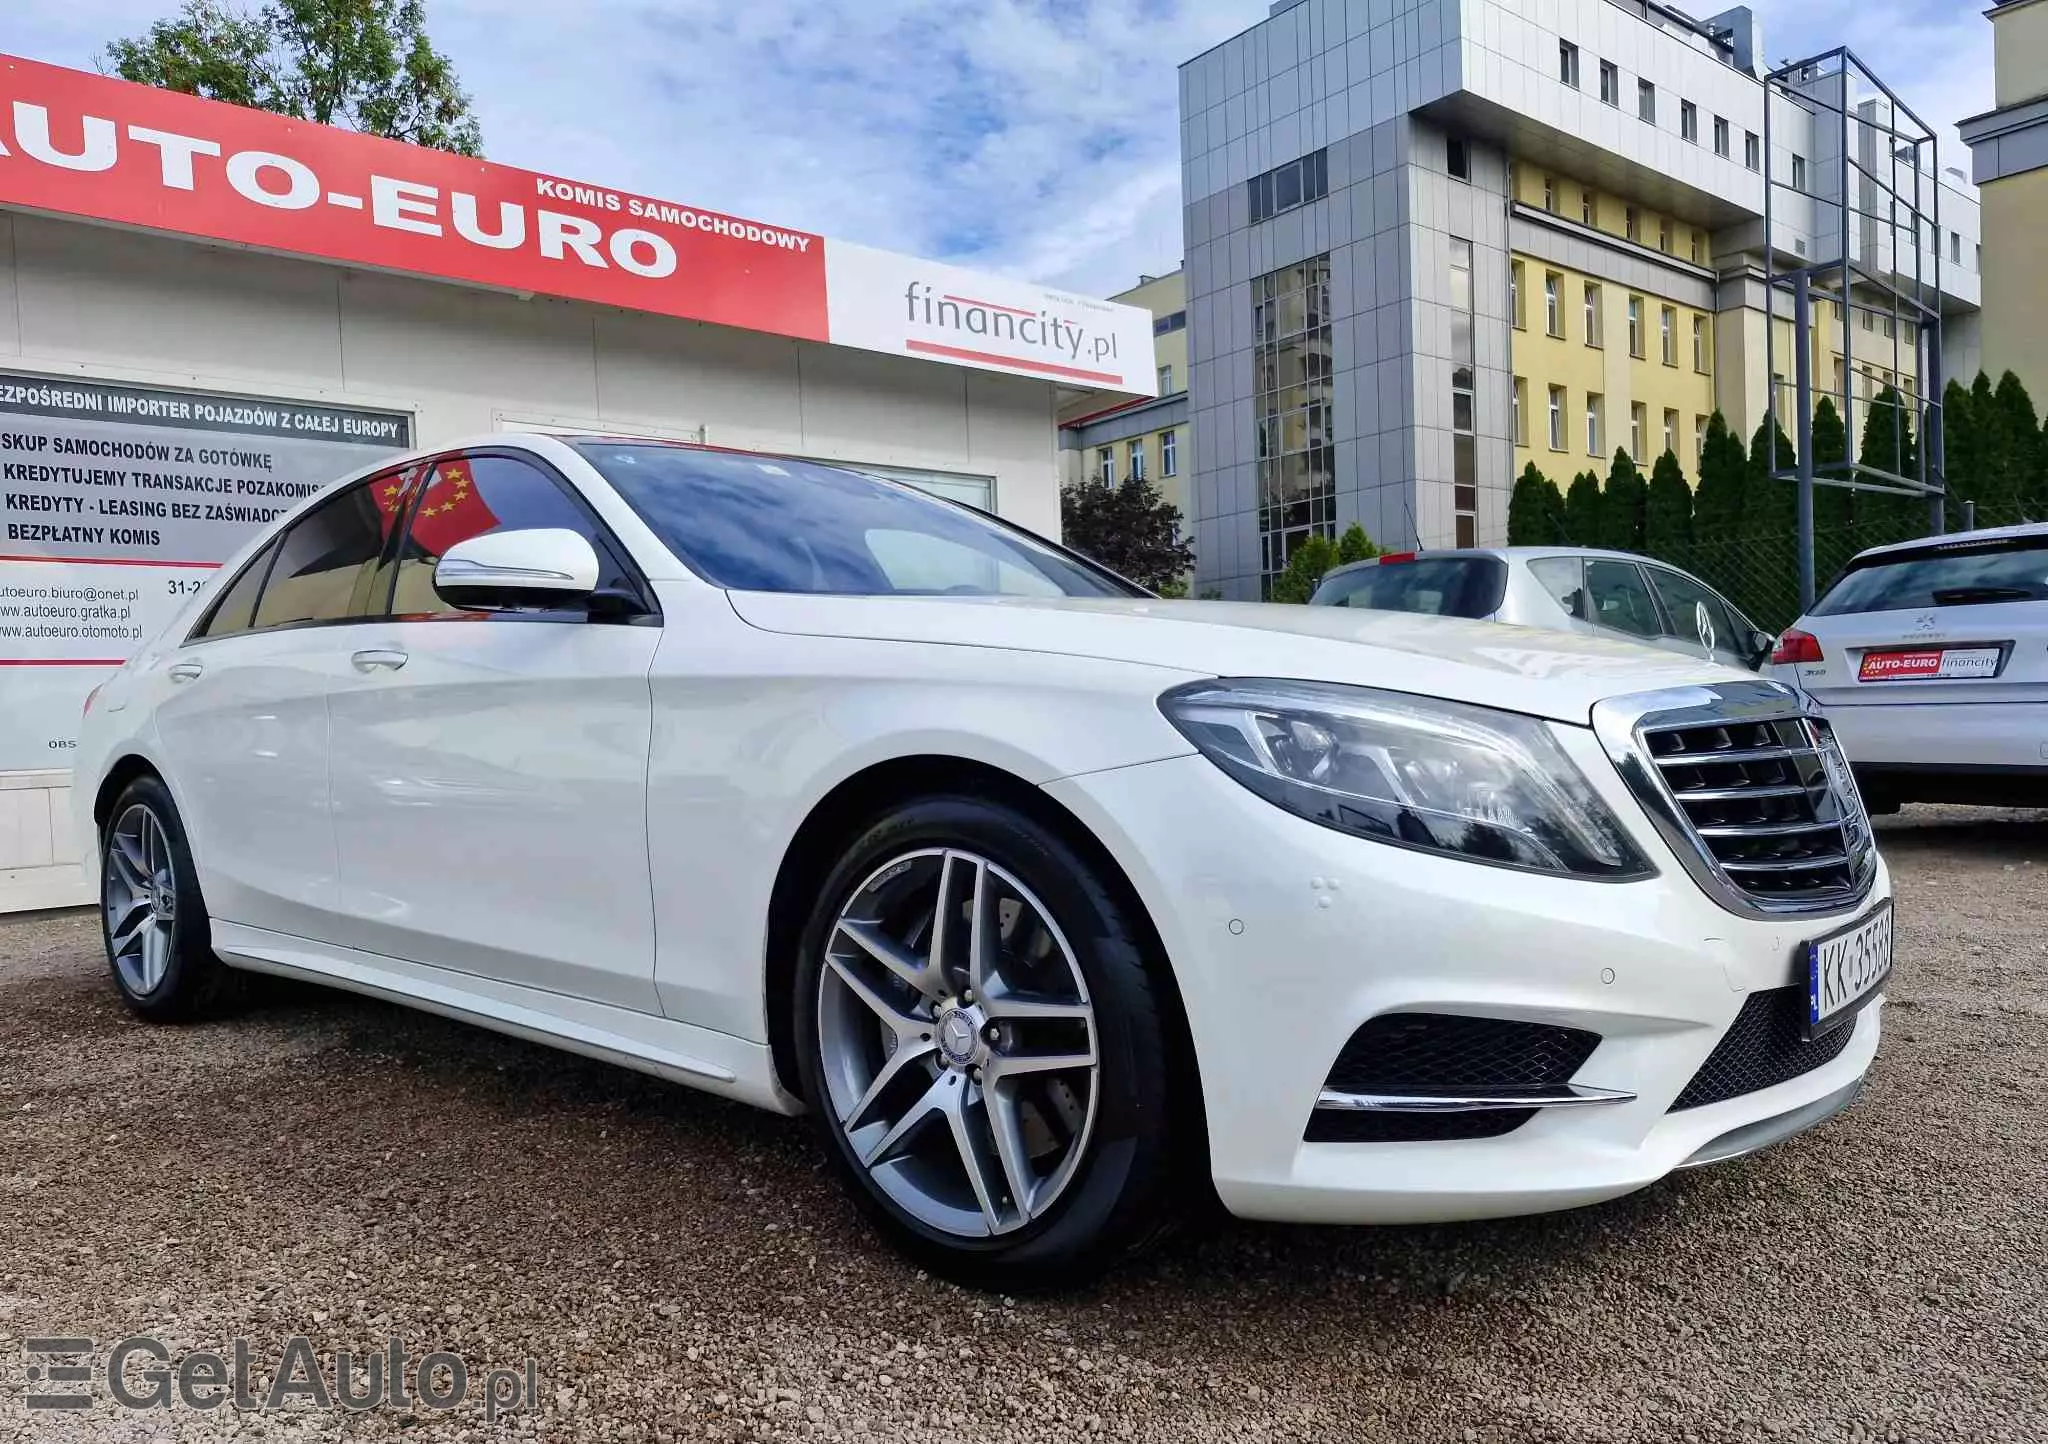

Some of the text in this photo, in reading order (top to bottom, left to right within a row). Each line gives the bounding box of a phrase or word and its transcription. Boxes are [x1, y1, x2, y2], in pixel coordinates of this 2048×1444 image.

[0, 101, 677, 278] UTO-EURO
[536, 177, 810, 253] KOMIS SAMOCHODOWY
[904, 281, 1118, 363] financity.pl
[107, 395, 190, 420] IMPORTER
[194, 402, 277, 428] POJAZDÓW
[281, 412, 291, 430] Z
[294, 414, 339, 434] CAŁEJ
[342, 417, 399, 438] EUROPY
[1, 432, 272, 472] SKUP SAMOCHODÓW ZA GOTÓWKĘ
[4, 462, 126, 487] KREDYTUJEMY
[132, 471, 233, 494] TRANSAKCJE
[6, 492, 83, 514] KREDYTY
[99, 499, 167, 518] LEASING
[171, 503, 200, 519] BEZ
[204, 501, 288, 524] ZAŚWIADC
[7, 522, 160, 546] BEZPŁATNY KOMIS
[168, 580, 207, 594] 31-2
[1868, 657, 1938, 670] AUTO-EURO
[1823, 939, 1848, 1012] KK
